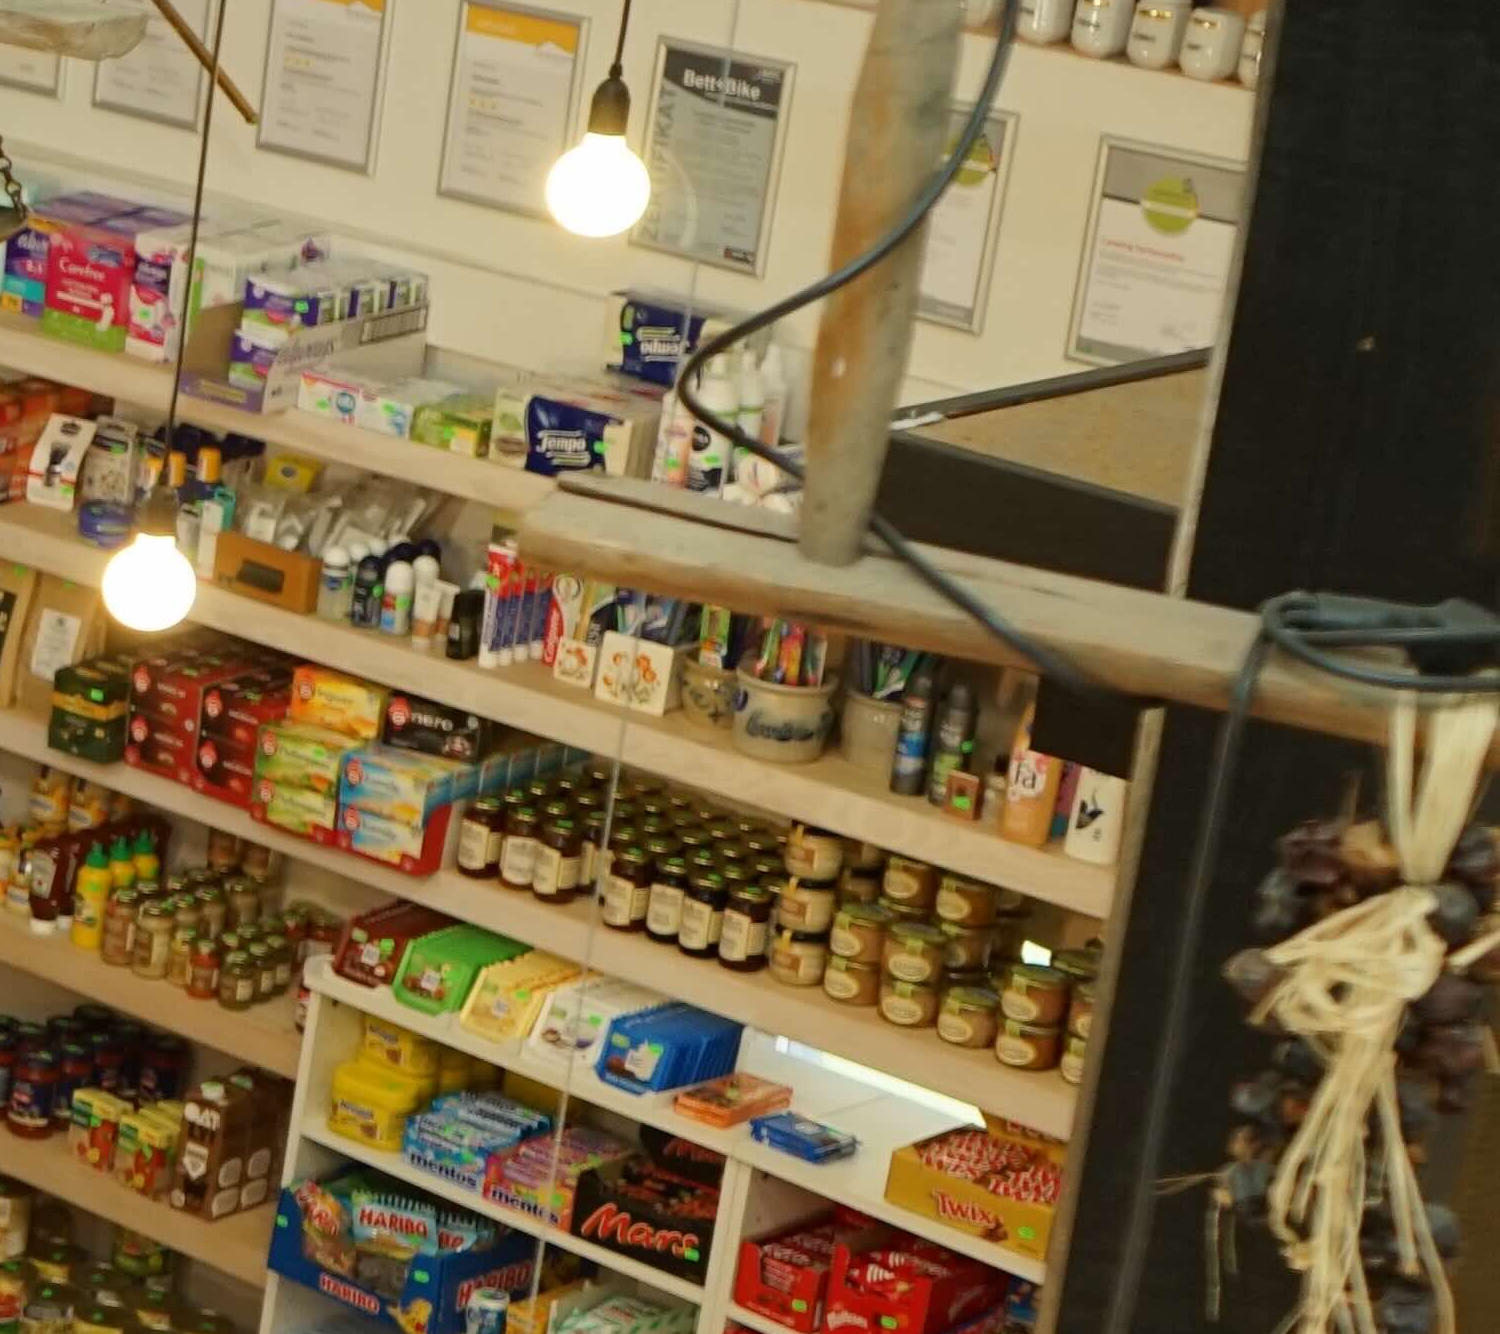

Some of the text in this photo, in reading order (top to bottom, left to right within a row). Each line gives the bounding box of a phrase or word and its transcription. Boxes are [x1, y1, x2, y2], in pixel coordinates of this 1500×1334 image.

[535, 431, 587, 455] Tempo
[410, 1151, 478, 1189] mentos
[359, 1207, 428, 1239] HARIBO
[491, 1189, 560, 1225] mentos
[582, 1202, 700, 1259] Mars
[318, 1271, 381, 1314] HARIBO
